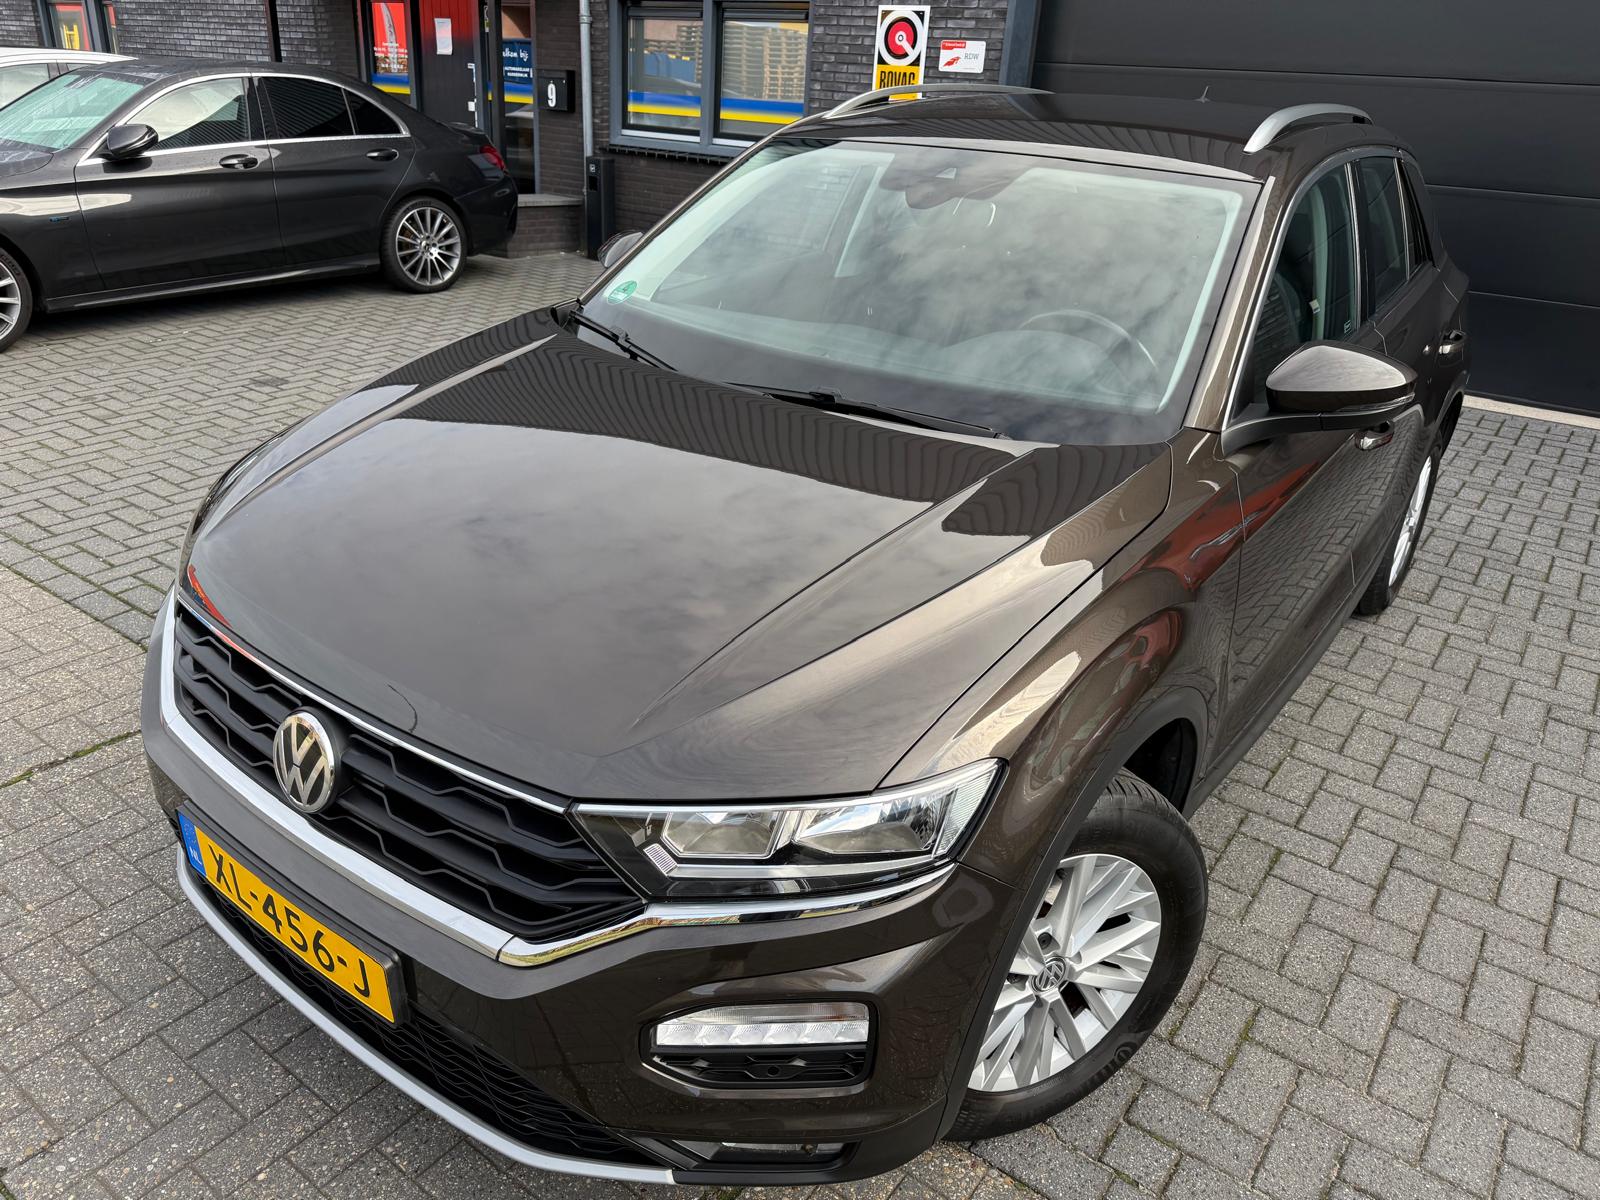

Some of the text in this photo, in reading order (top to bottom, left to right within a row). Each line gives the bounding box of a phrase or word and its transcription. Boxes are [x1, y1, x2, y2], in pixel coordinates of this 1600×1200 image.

[547, 83, 556, 107] 9
[272, 711, 335, 813] VW
[189, 845, 203, 866] NL
[208, 844, 370, 998] XL-456-J
